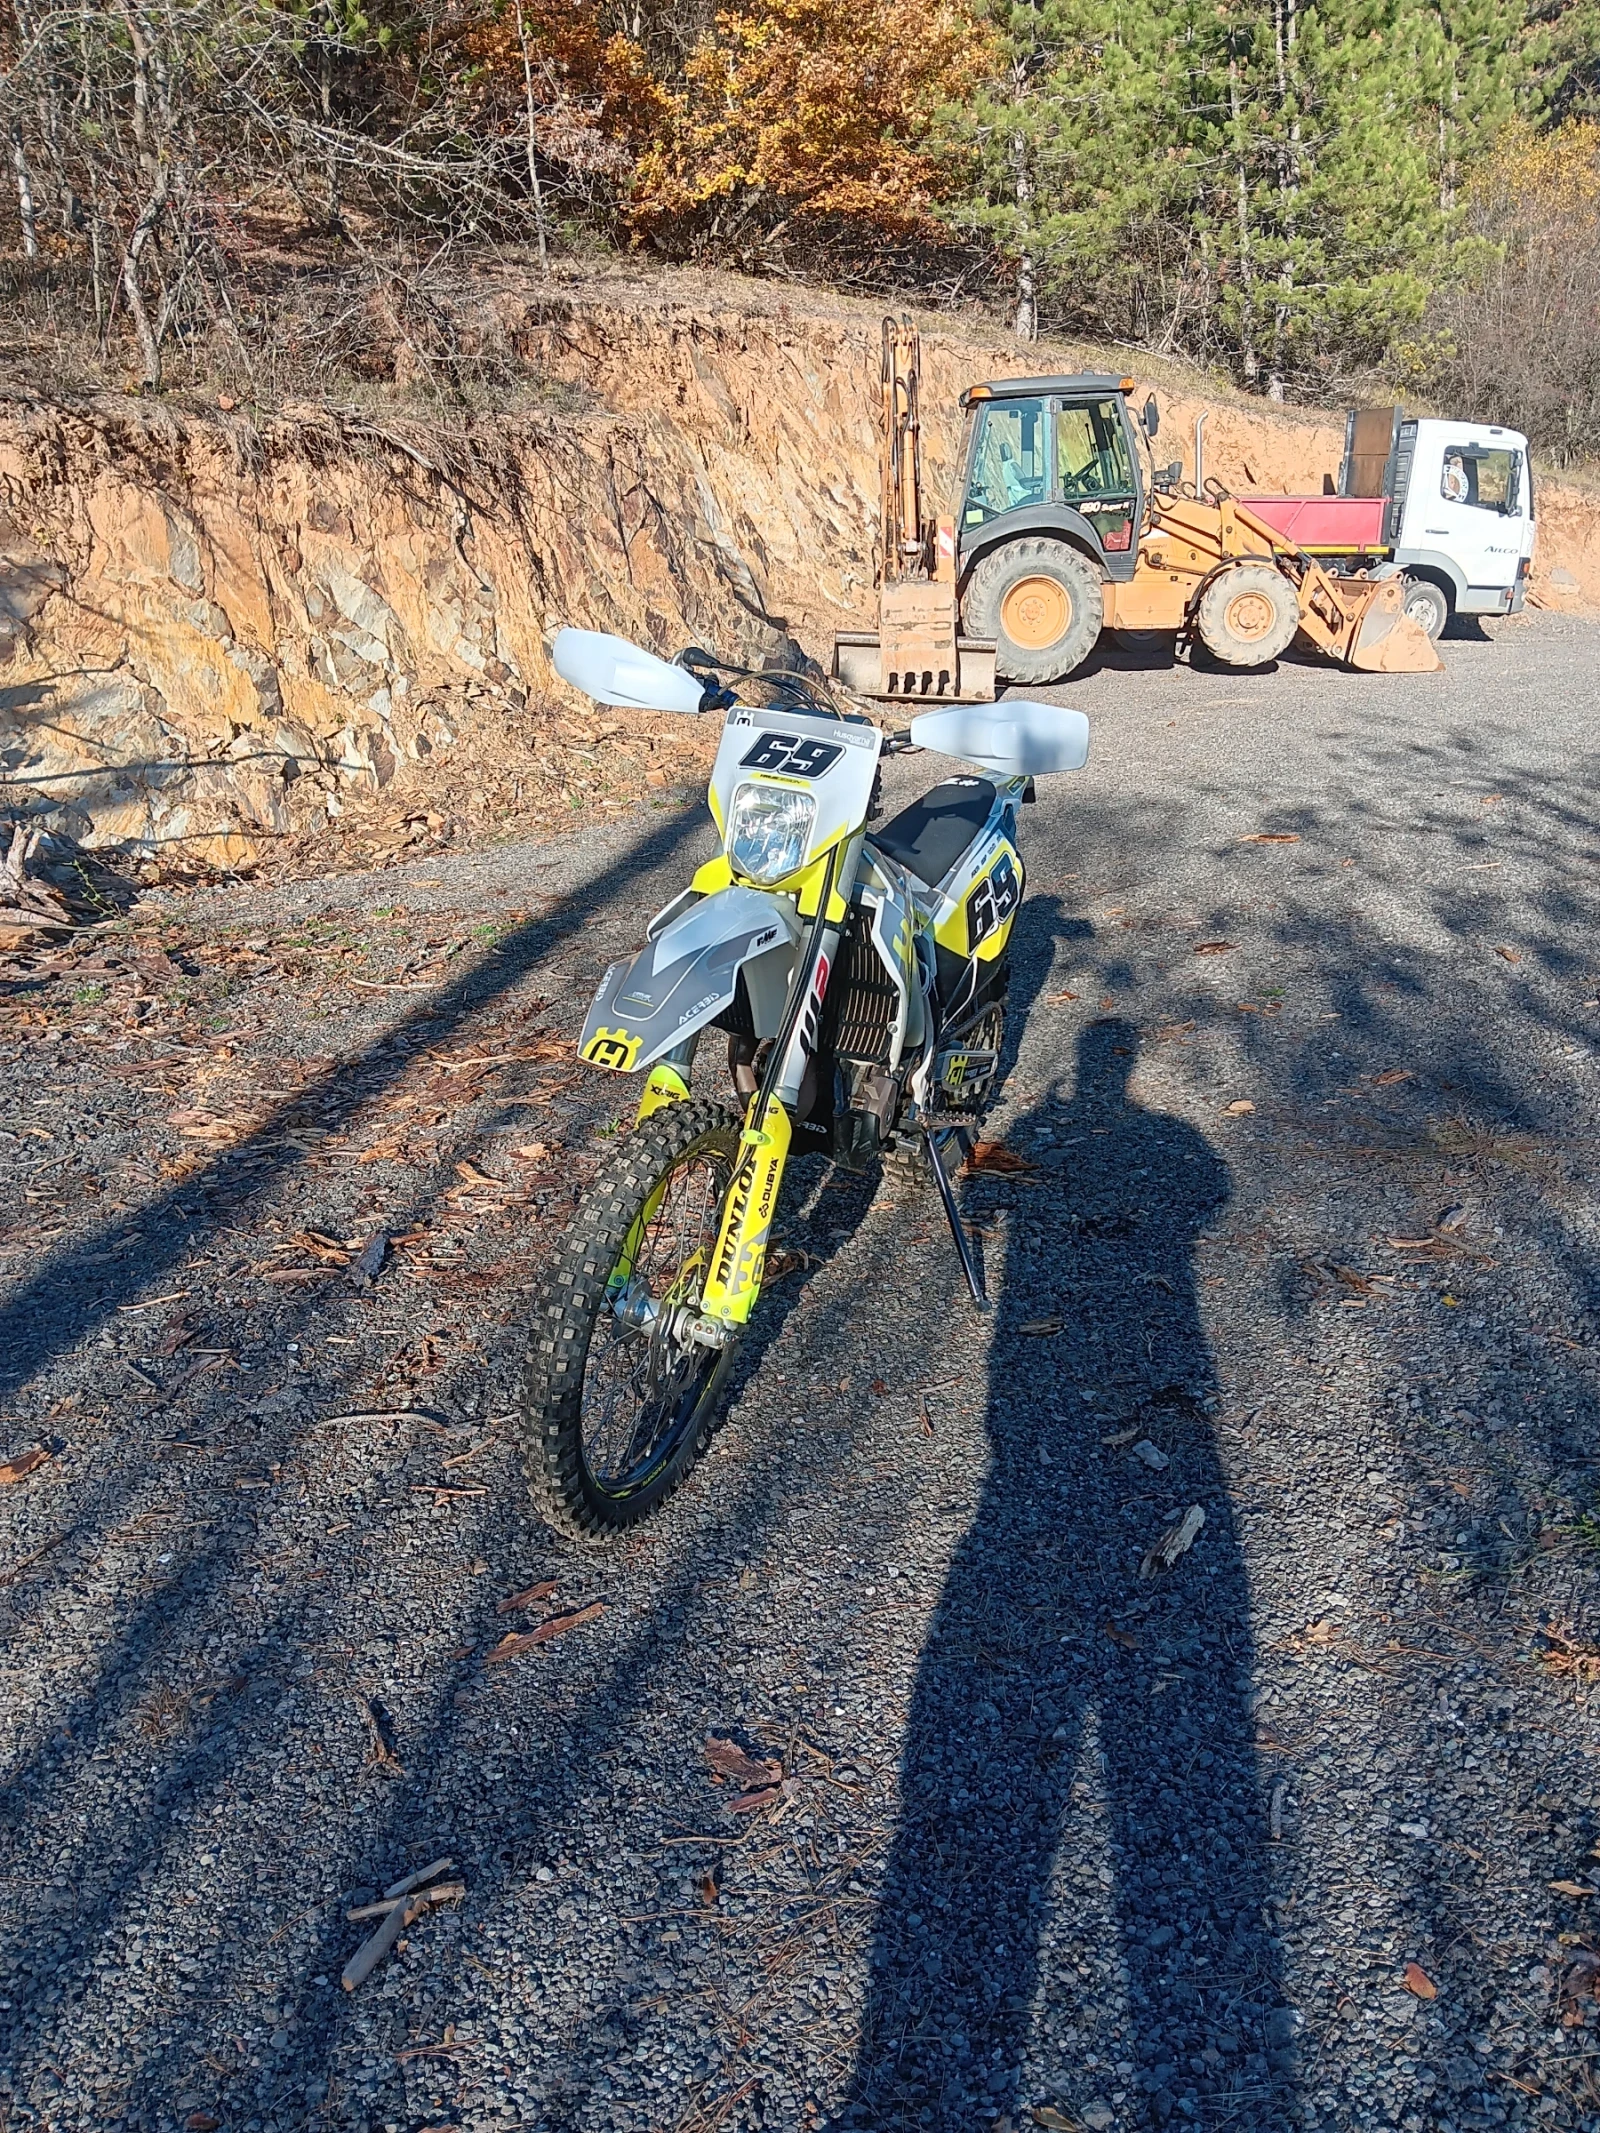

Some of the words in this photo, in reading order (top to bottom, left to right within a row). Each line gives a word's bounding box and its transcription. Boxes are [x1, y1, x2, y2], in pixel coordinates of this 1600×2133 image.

[1079, 501, 1101, 514] 590
[1101, 503, 1122, 511] Super
[833, 729, 871, 746] Husqvarna
[738, 732, 846, 780] 69
[966, 851, 1020, 957] 69
[595, 966, 616, 1002] ACERBIS
[678, 992, 721, 1026] ACERBIS
[762, 1158, 779, 1202] DUBYA
